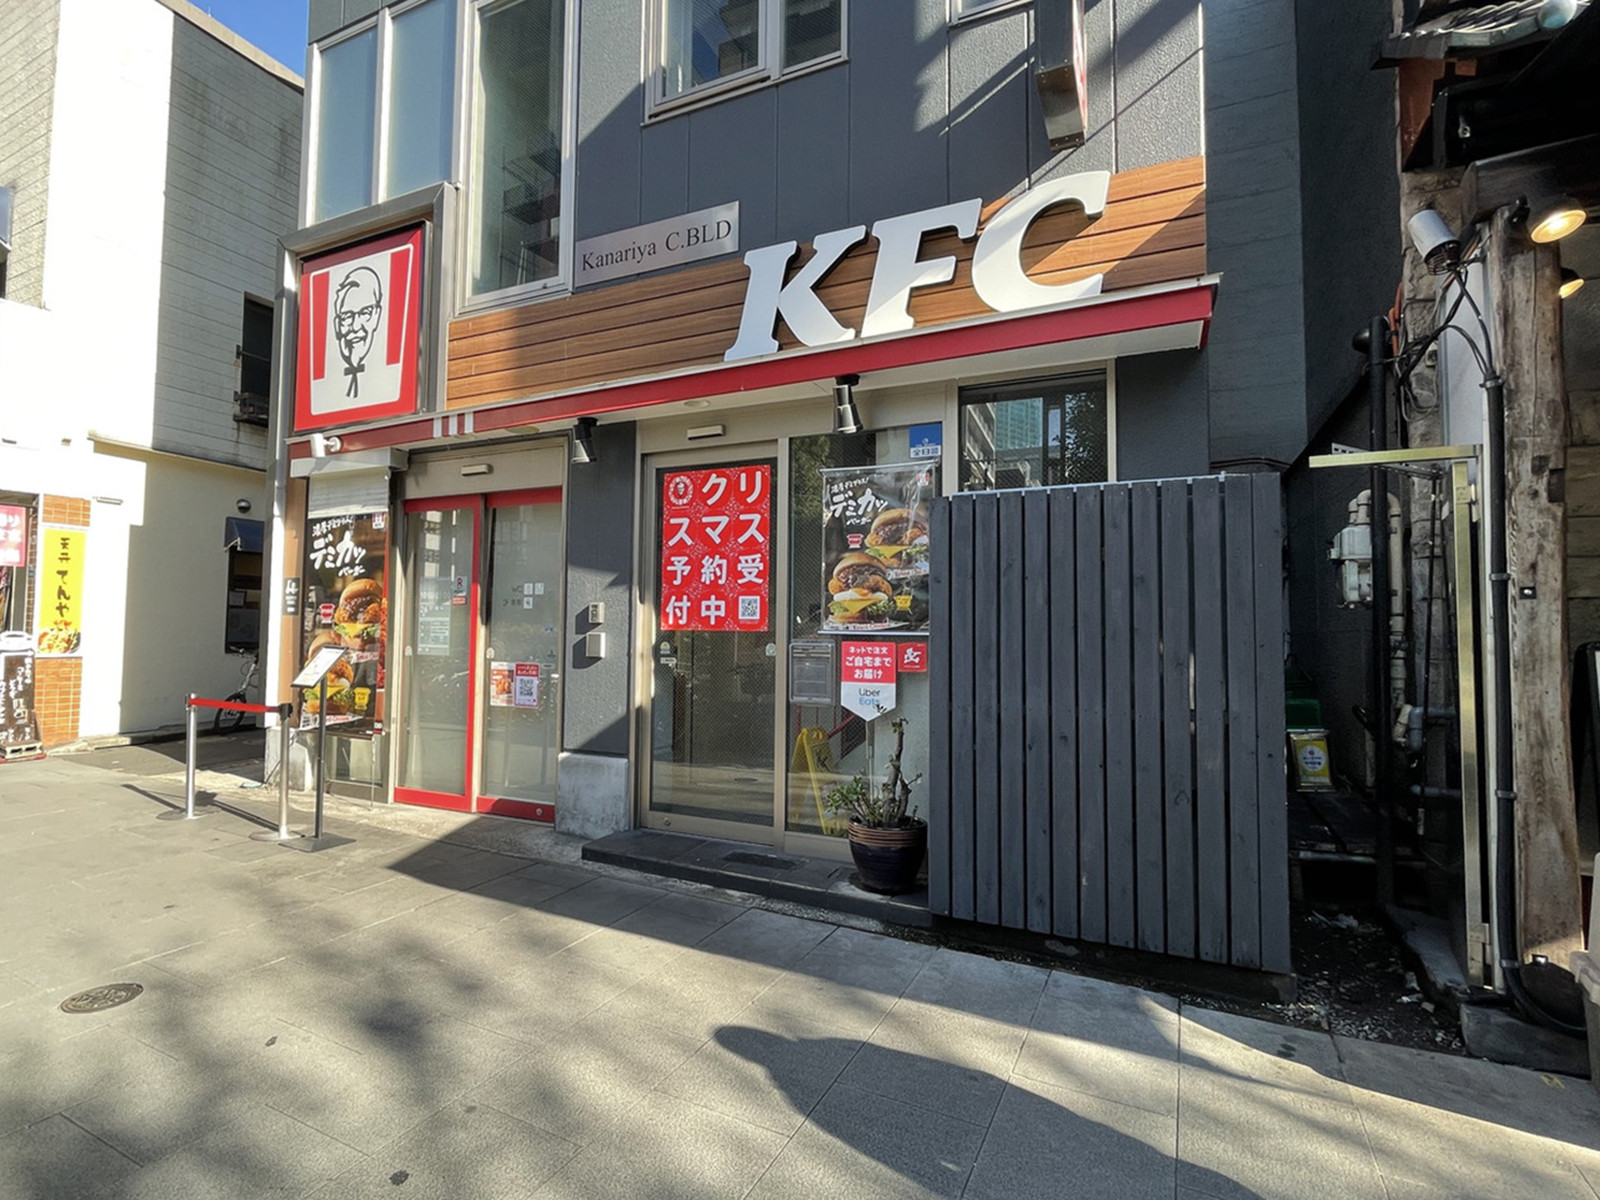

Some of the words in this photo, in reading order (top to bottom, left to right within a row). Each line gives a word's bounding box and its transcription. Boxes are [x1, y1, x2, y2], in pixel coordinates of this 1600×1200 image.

[582, 241, 657, 271] Kanariya
[665, 219, 732, 251] C.BLD
[724, 171, 1110, 361] KFC
[702, 470, 762, 506] クリ
[830, 487, 888, 518] デミカツ
[668, 513, 765, 546] スマス
[310, 530, 367, 570] デミカツ
[667, 554, 764, 585] 予約受
[55, 570, 71, 617] てんや
[666, 594, 726, 625] 付中
[845, 656, 892, 667] ご自宅まで
[849, 646, 888, 655] ネットで注文
[854, 668, 883, 679] お届け
[858, 688, 881, 697] Uber
